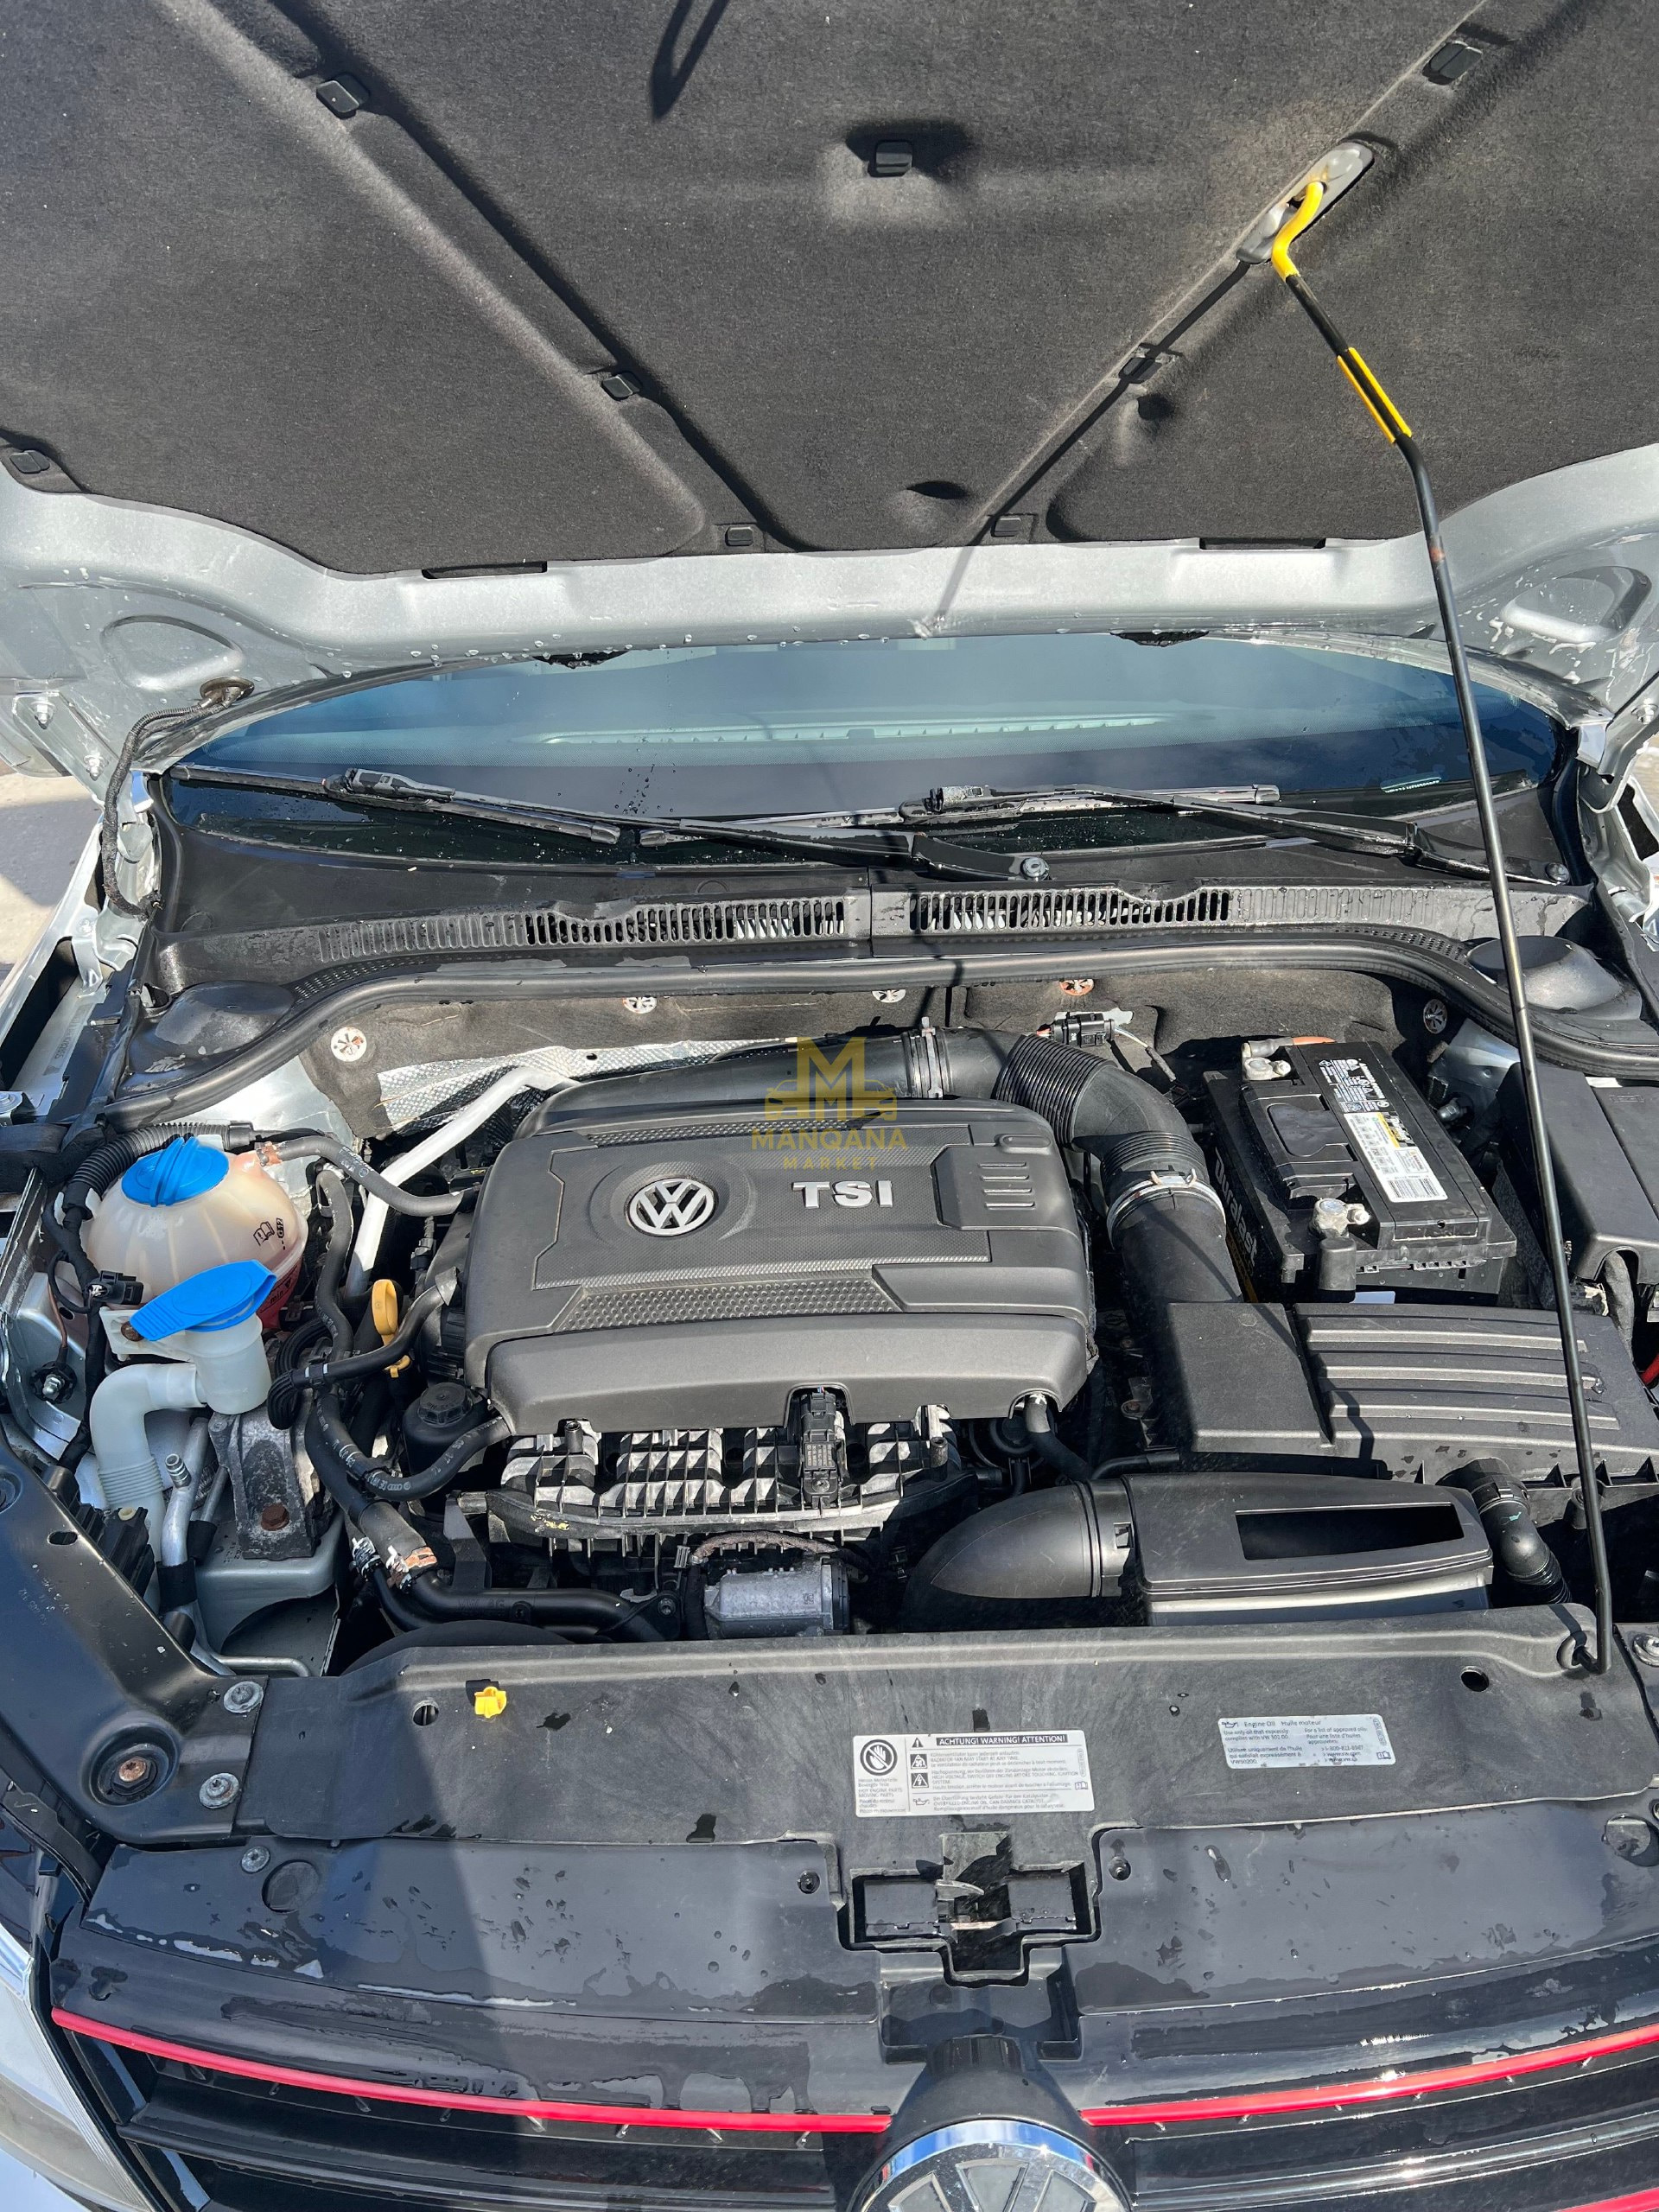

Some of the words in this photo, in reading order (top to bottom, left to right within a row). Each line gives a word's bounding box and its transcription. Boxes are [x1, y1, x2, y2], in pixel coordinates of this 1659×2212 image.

[791, 1179, 893, 1208] TSI
[939, 1737, 979, 1745] ACHTUNG!
[980, 1736, 1020, 1745] WARNING!
[1021, 1734, 1066, 1744] ATTENTION!
